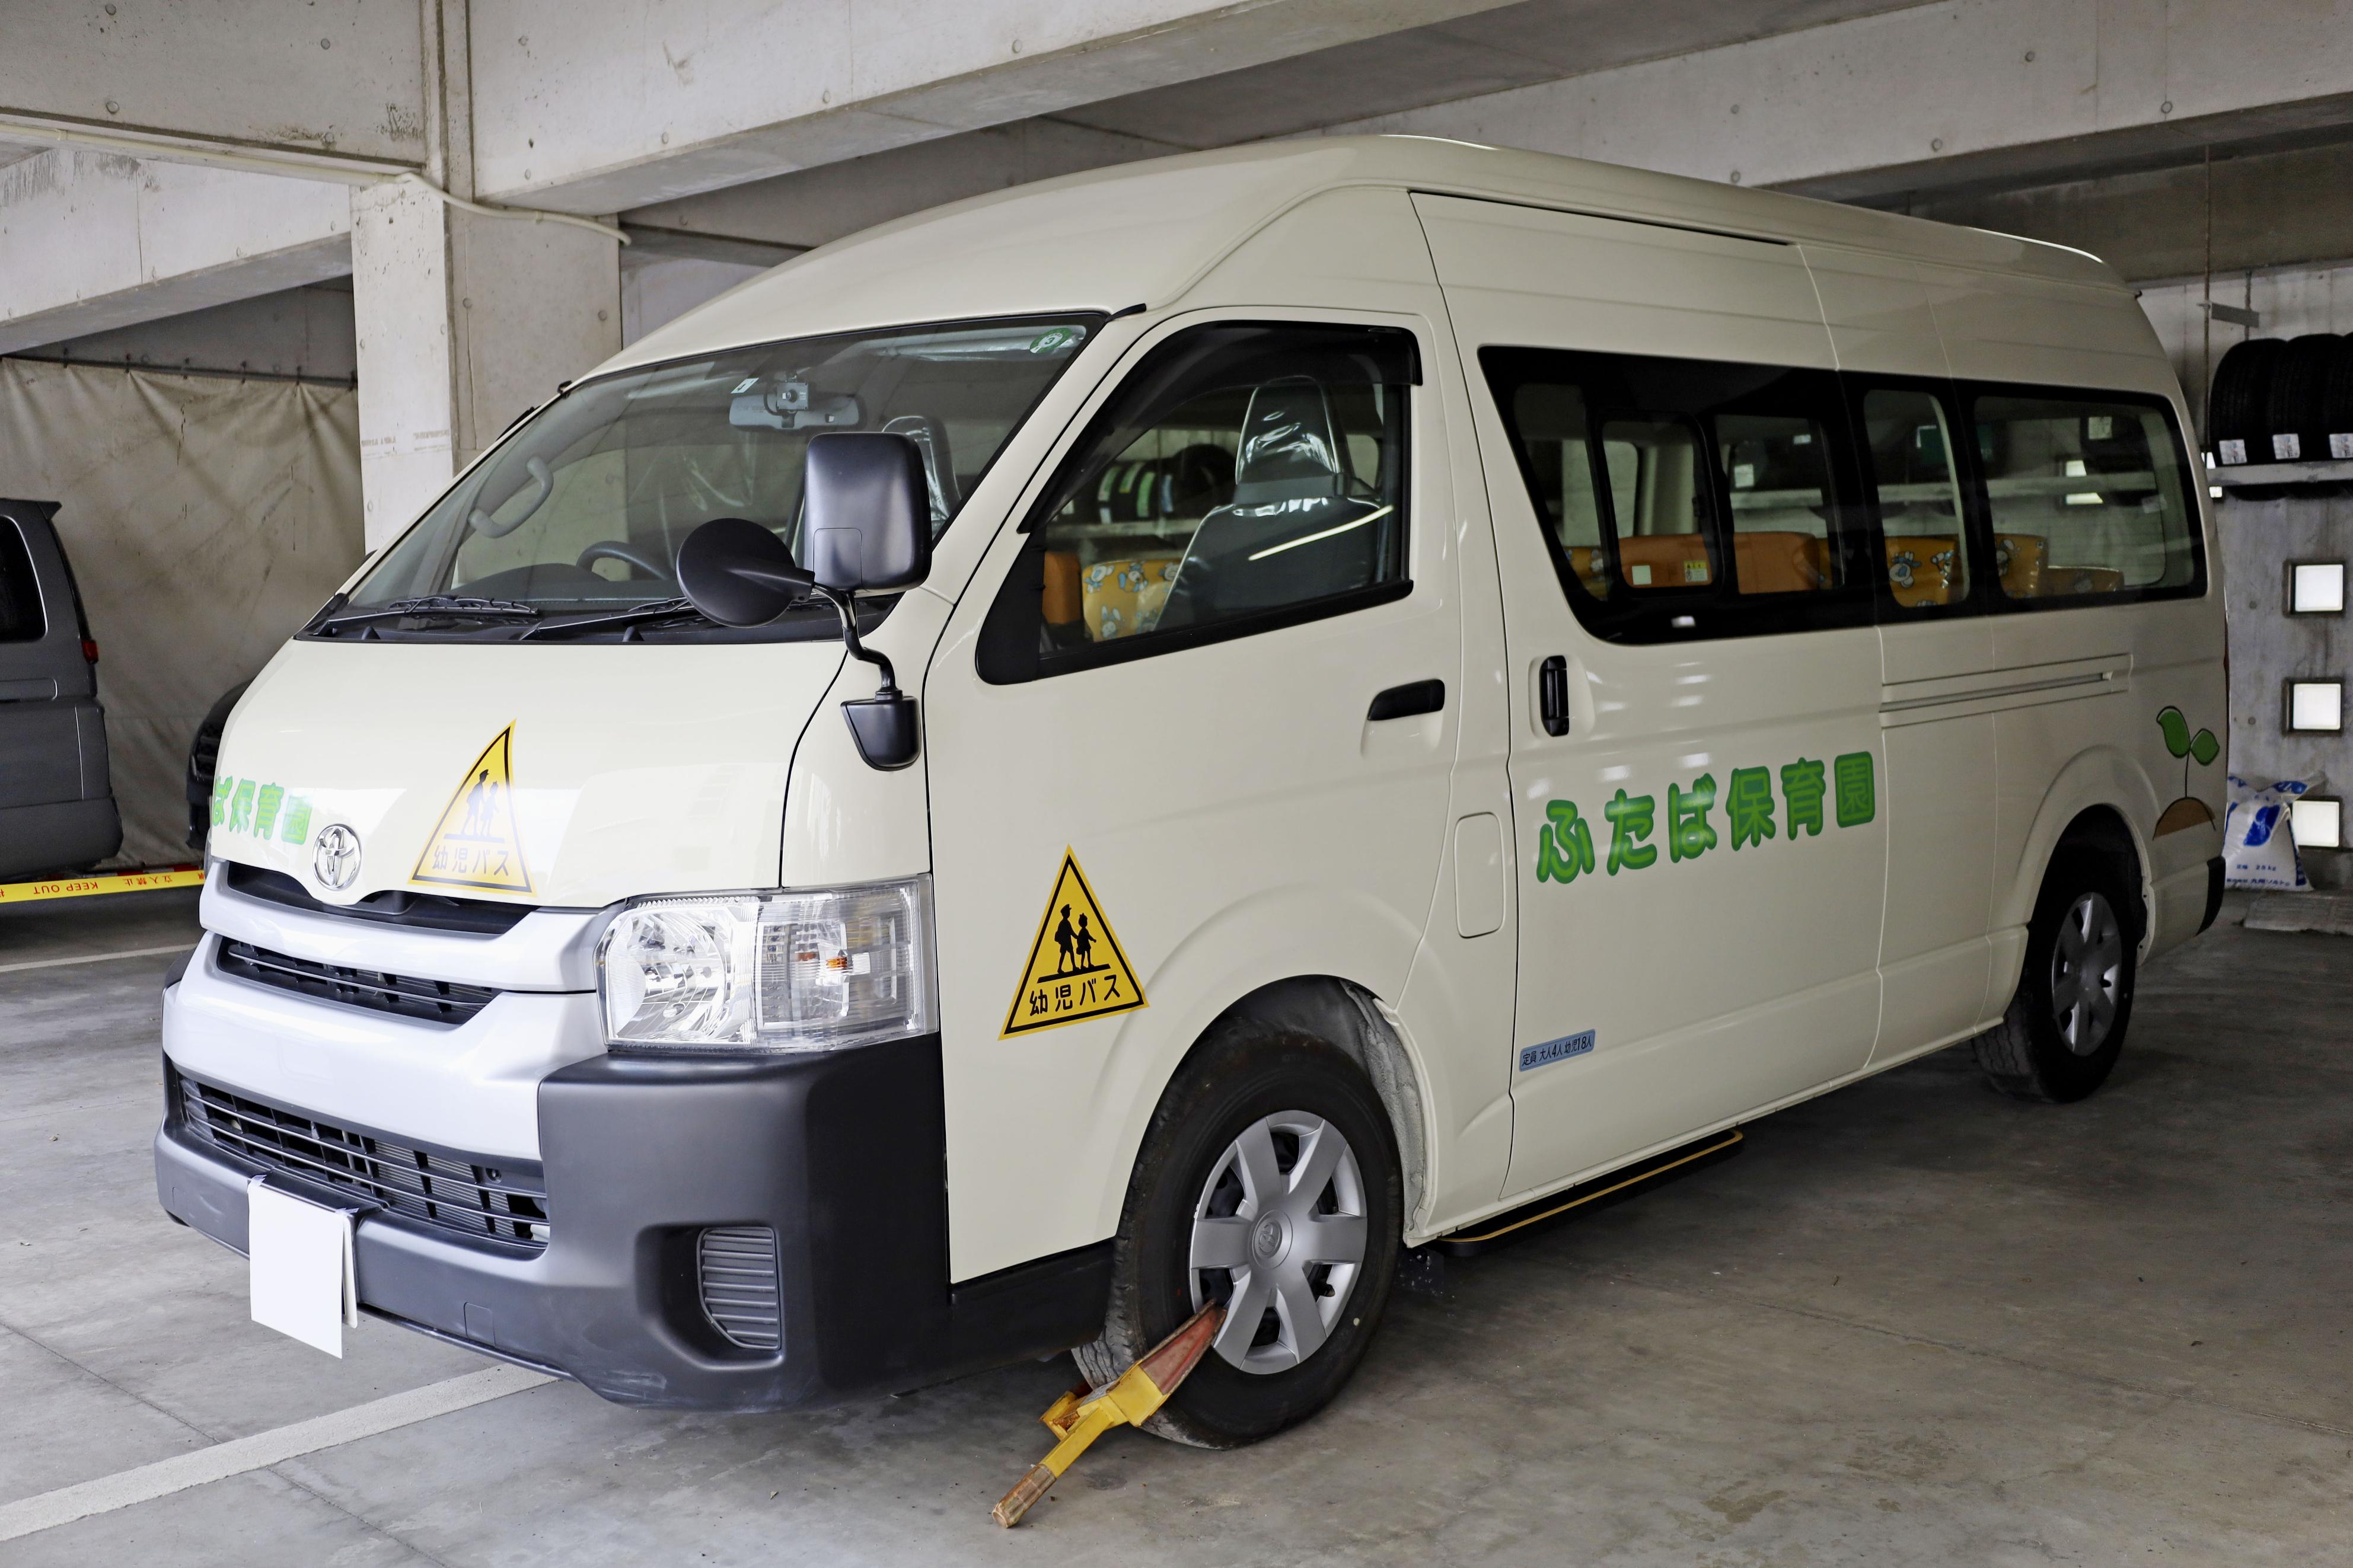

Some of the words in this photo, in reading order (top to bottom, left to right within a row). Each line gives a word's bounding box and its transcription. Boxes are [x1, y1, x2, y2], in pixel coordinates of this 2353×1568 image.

[1536, 751, 1876, 884] ふたば保育園
[432, 844, 509, 877] 幼児バス
[33, 884, 60, 895] OUT
[66, 881, 98, 892] KEEP
[123, 874, 173, 887] 立入禁止
[1029, 974, 1120, 1017] 幼児バス
[1522, 1050, 1537, 1066] 定員
[1539, 1043, 1563, 1062] 大人4人
[1564, 1036, 1592, 1054] 幼児18人
